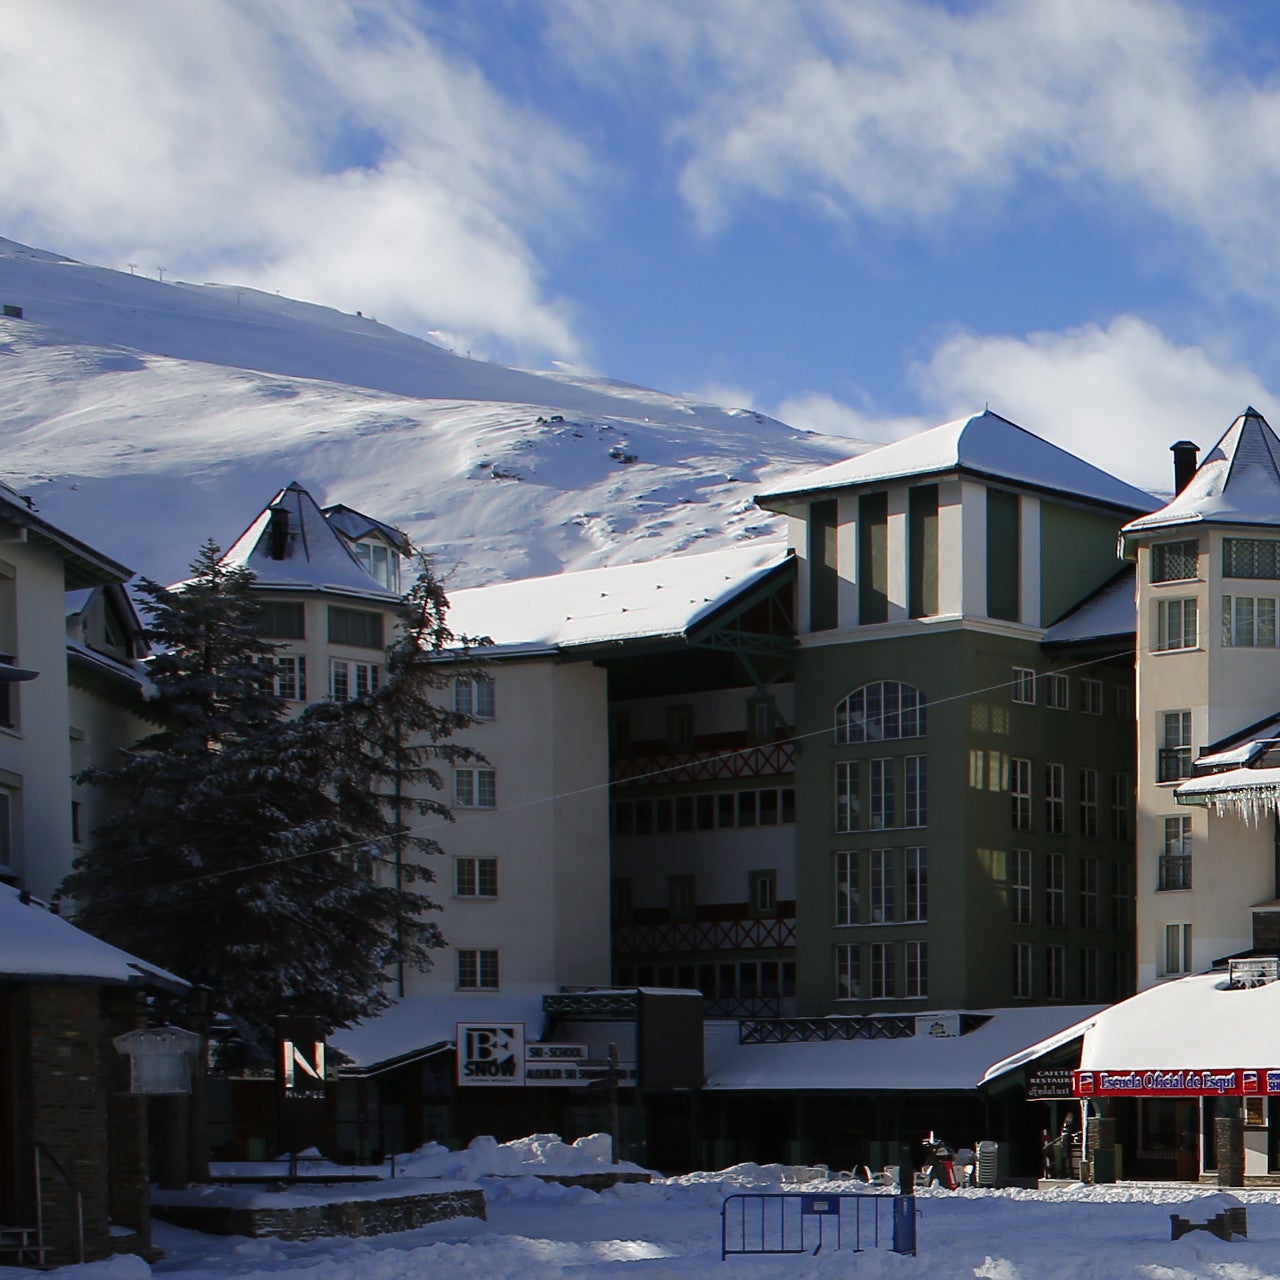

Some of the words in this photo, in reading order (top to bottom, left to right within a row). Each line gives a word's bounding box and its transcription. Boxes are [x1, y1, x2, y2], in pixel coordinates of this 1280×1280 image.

[464, 1061, 517, 1077] SNOW
[526, 1069, 562, 1080] ALQUILER
[564, 1069, 577, 1080] SKI
[1100, 1071, 1141, 1089] Escuela
[1144, 1070, 1183, 1089] Oficial
[1185, 1071, 1201, 1089] de
[1202, 1071, 1235, 1093] Esquí
